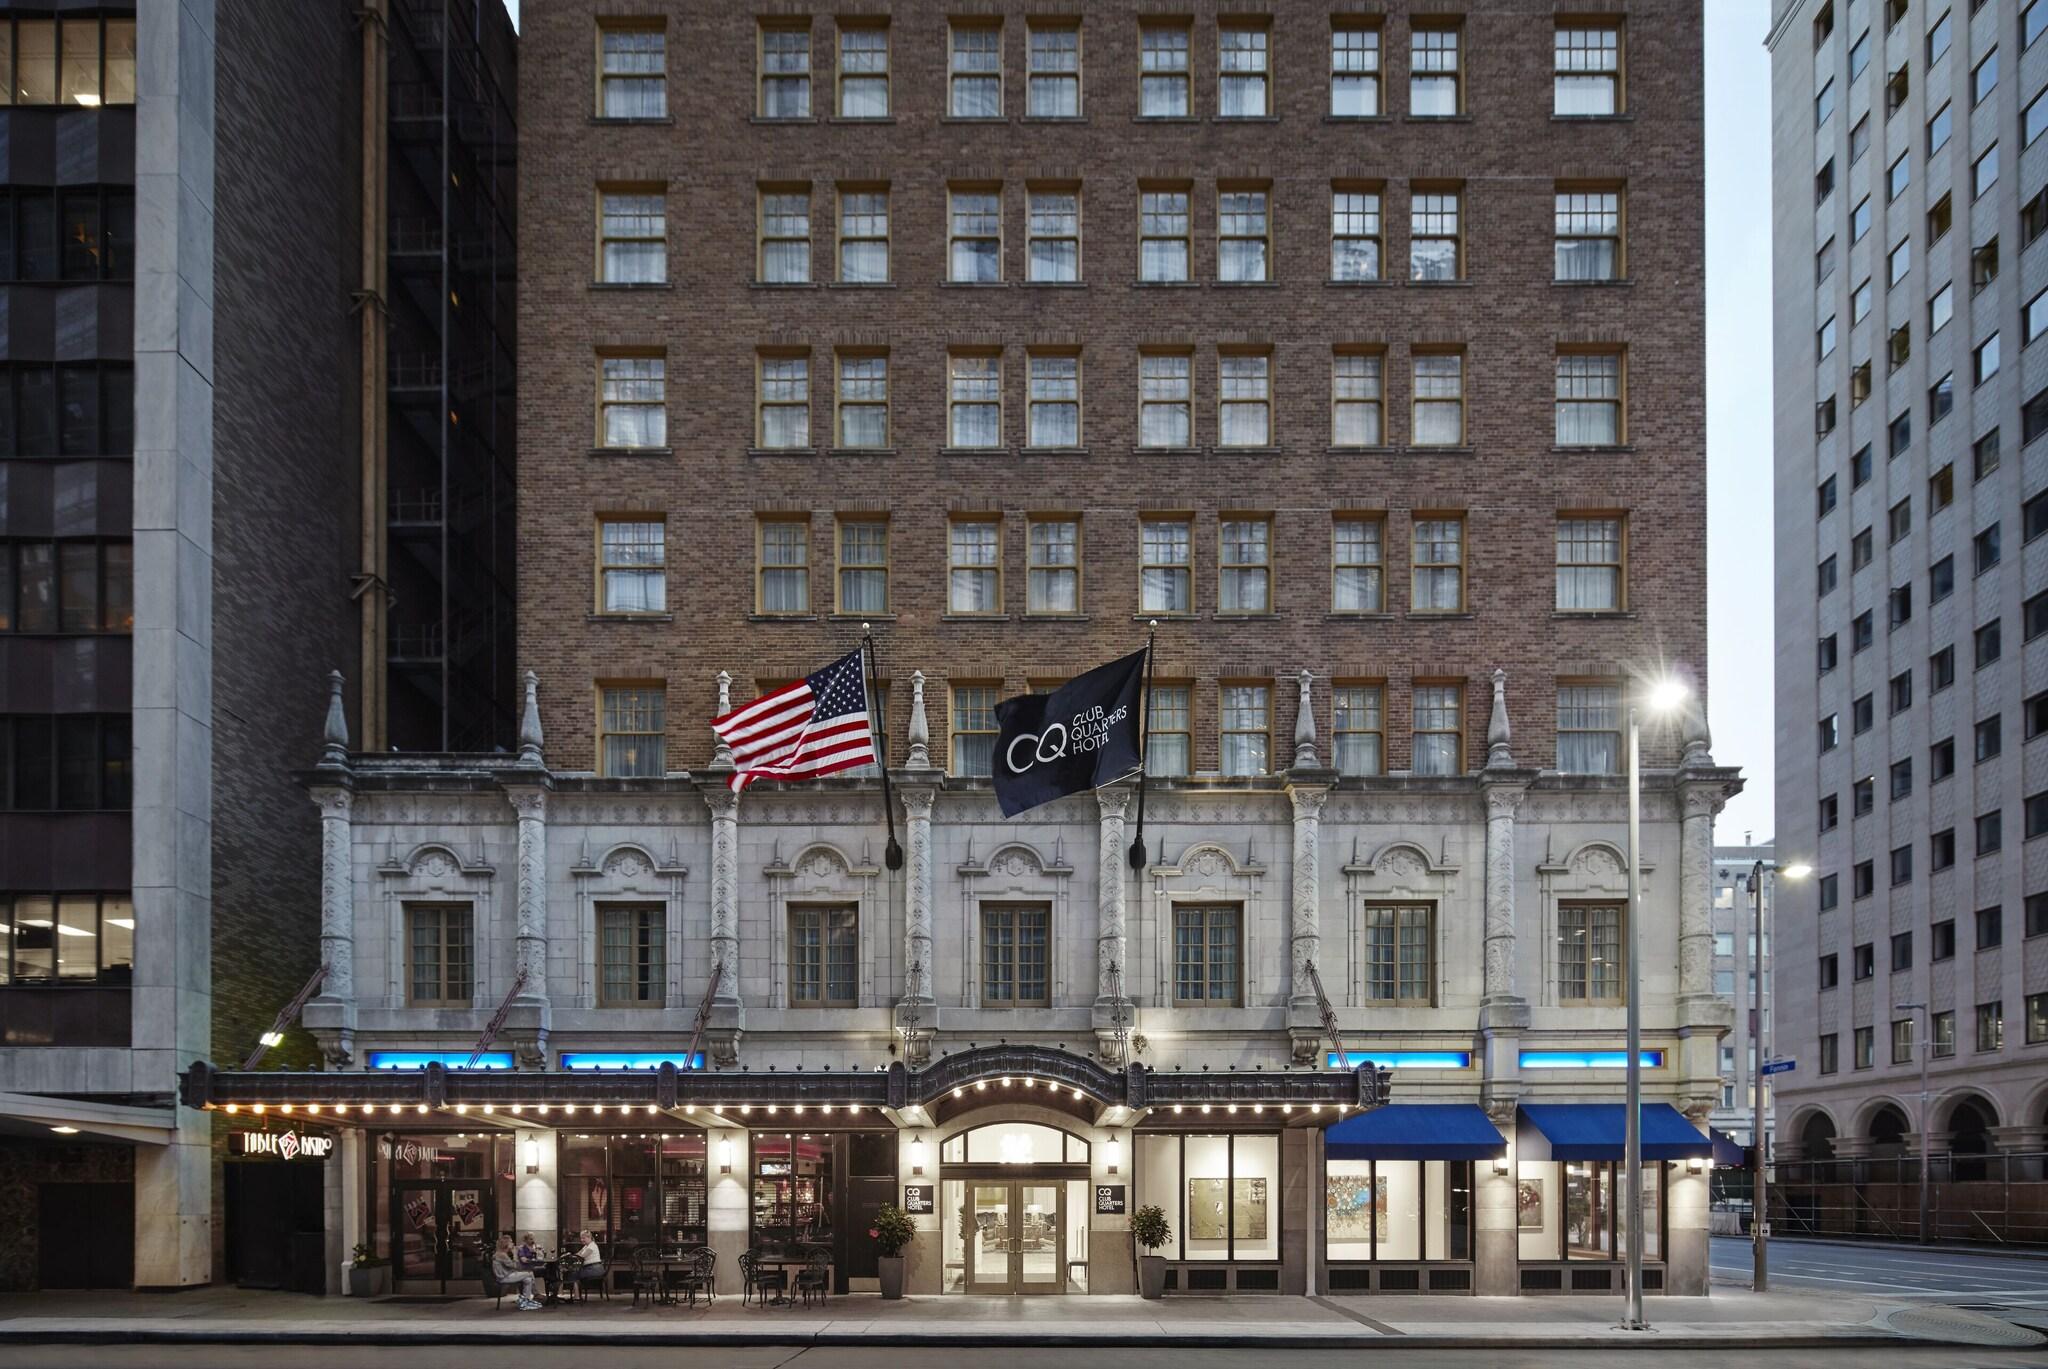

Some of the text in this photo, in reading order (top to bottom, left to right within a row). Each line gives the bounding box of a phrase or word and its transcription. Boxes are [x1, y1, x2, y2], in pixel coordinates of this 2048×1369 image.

[1071, 705, 1127, 741] QUARTERS
[1073, 705, 1104, 726] CLUB
[1006, 723, 1067, 774] CQ
[243, 1132, 278, 1154] TABLE
[301, 1136, 332, 1156] BISTRO
[907, 1188, 920, 1196] CQ
[1099, 1188, 1112, 1196] CQ
